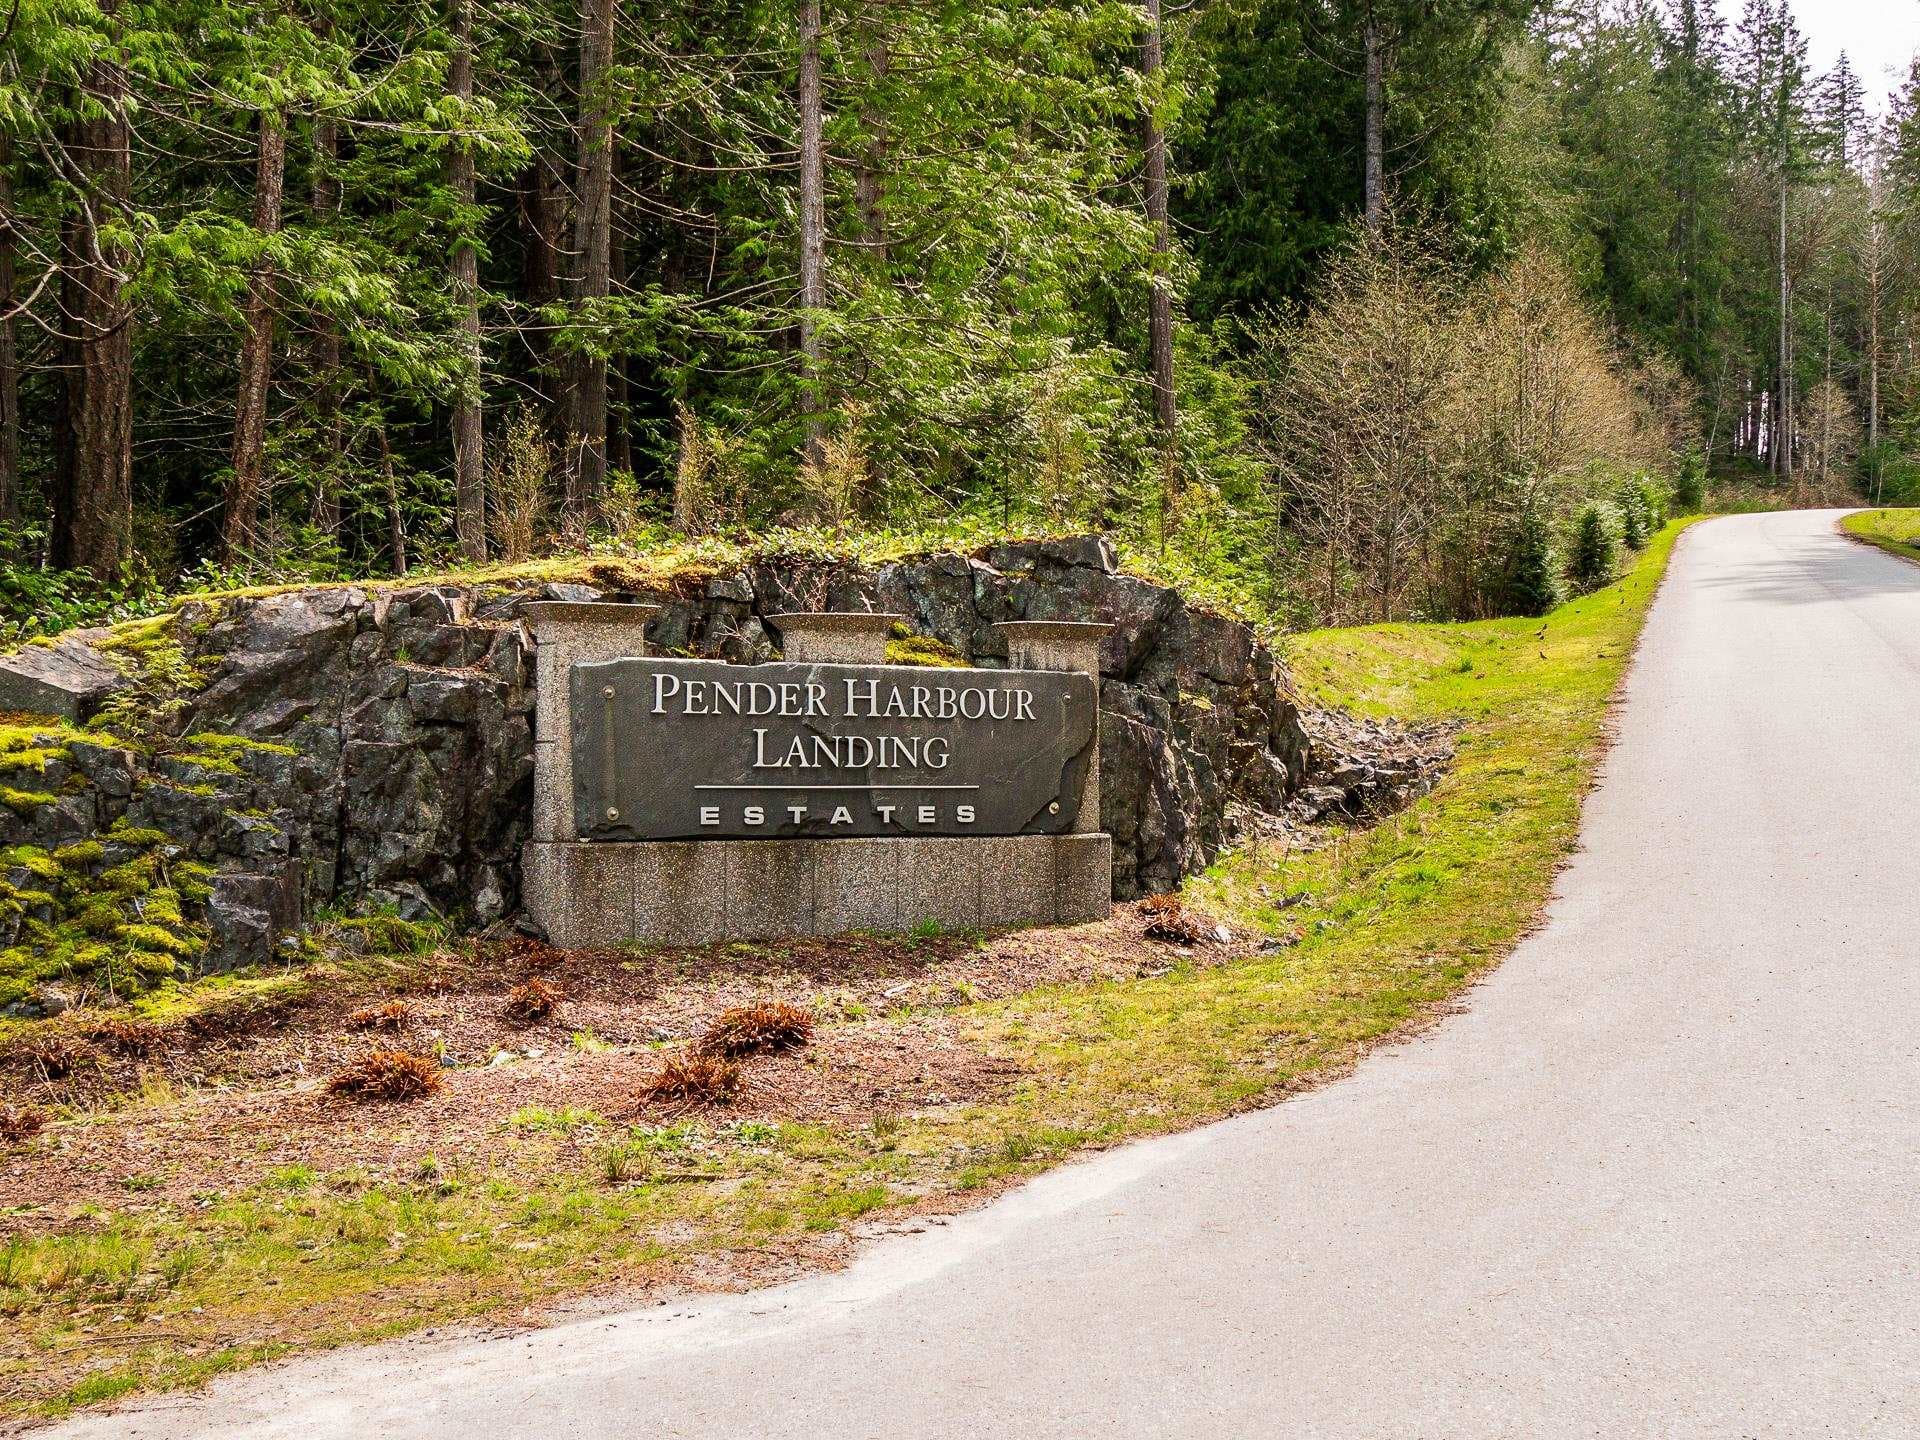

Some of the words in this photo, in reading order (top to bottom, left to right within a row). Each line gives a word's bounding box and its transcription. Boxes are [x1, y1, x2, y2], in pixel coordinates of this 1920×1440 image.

[651, 672, 829, 718] PENDER
[843, 678, 1037, 721] HARBOUR
[752, 728, 950, 769] LANDING
[699, 804, 977, 826] ESTATES
